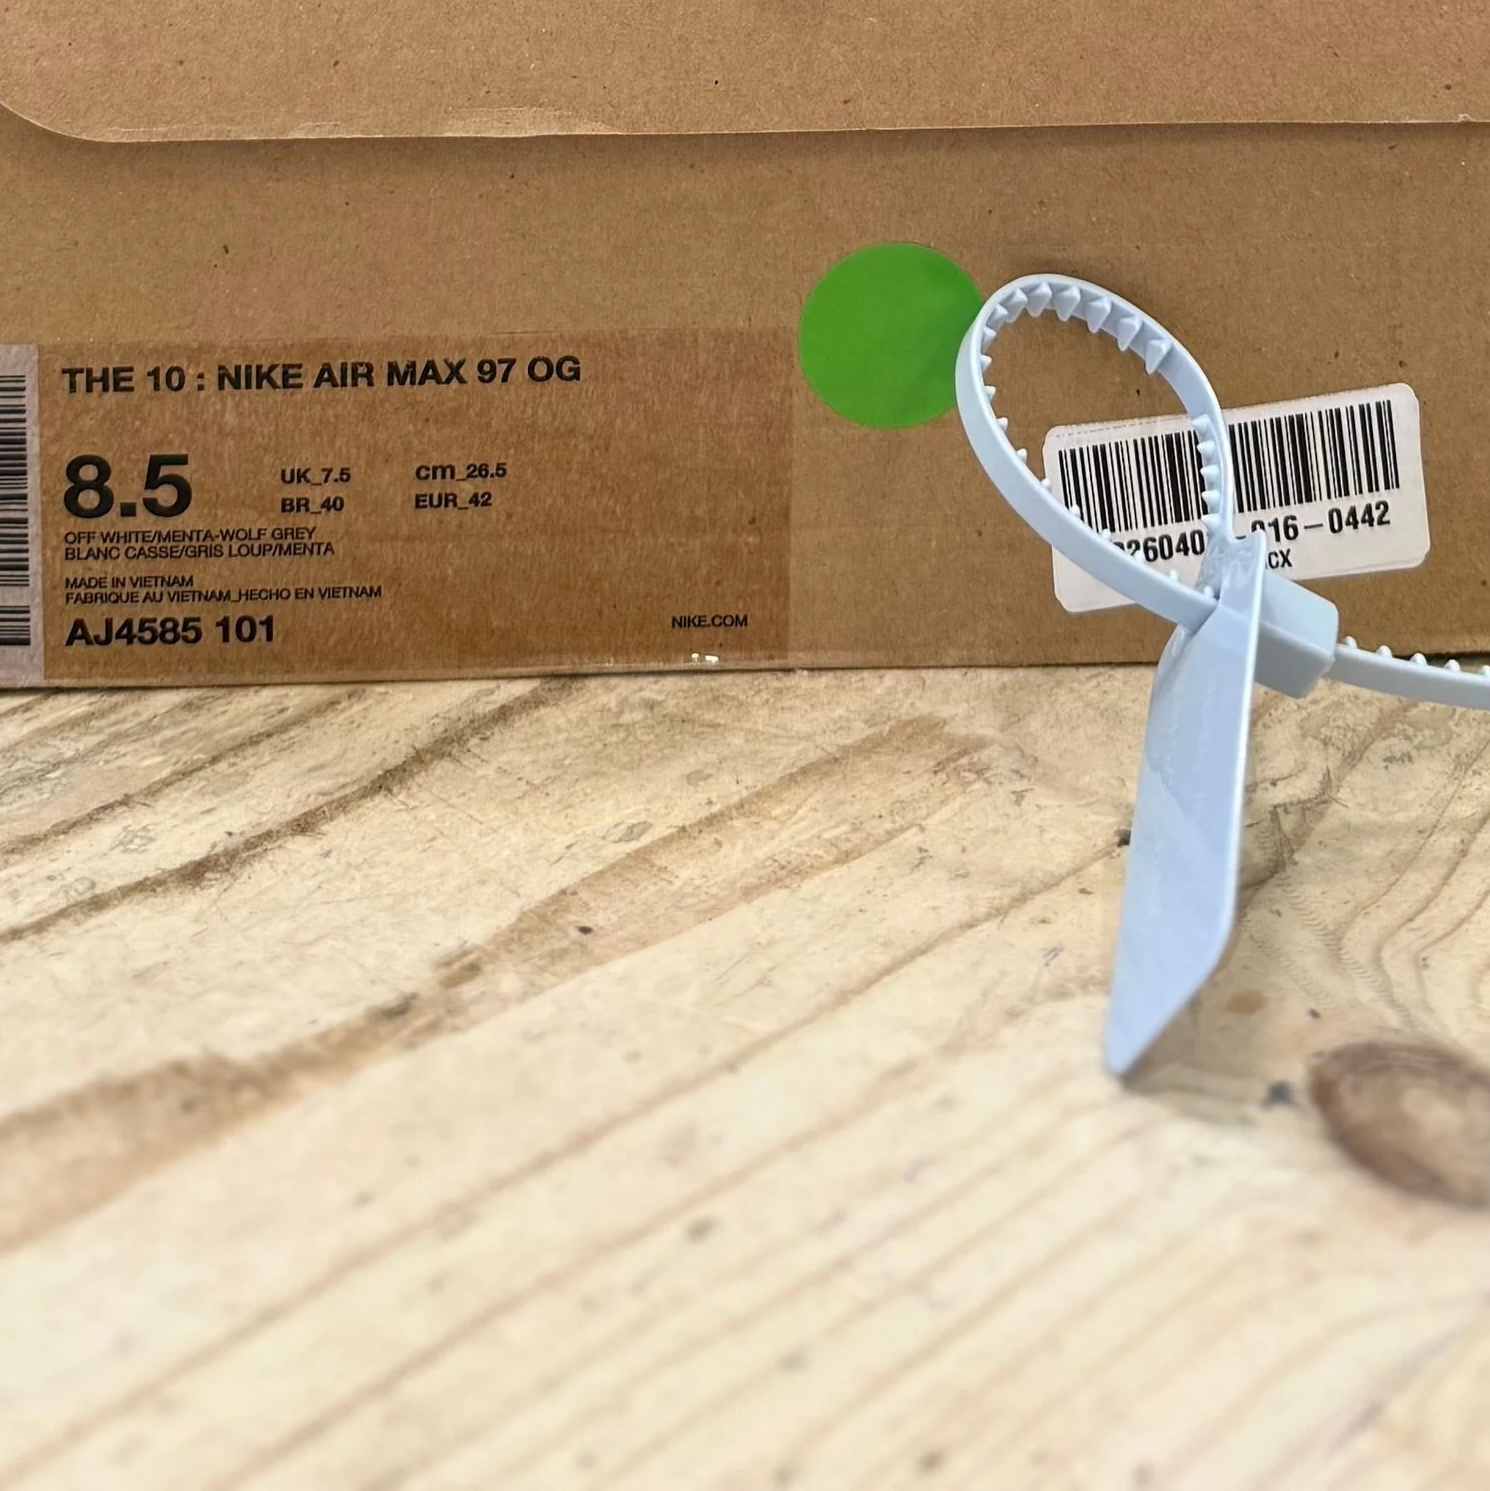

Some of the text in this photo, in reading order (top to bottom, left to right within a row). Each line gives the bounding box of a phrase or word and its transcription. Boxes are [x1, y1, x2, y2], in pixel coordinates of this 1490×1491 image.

[61, 355, 582, 393] THE 10 : NIKE AIR MAX 97 OG
[280, 466, 352, 486] UK_7.5
[415, 461, 507, 482] cm_26.5
[63, 453, 193, 518] 8.5
[280, 495, 345, 514] BR_40
[414, 490, 493, 510] EUR_42
[64, 526, 316, 545] OFF WHITE/MENTA-WOLF GREY
[64, 541, 335, 560] BLANC CASSE/GRIS LOUP/MENTA
[1265, 548, 1293, 569] CX
[65, 574, 194, 590] MADE IN VIETNAM
[65, 585, 382, 605] FABRIQUE AU VIETNAM_HECHO EN VIETNAM
[65, 615, 275, 646] AJ4585 101
[671, 614, 748, 628] NIKE.COM
